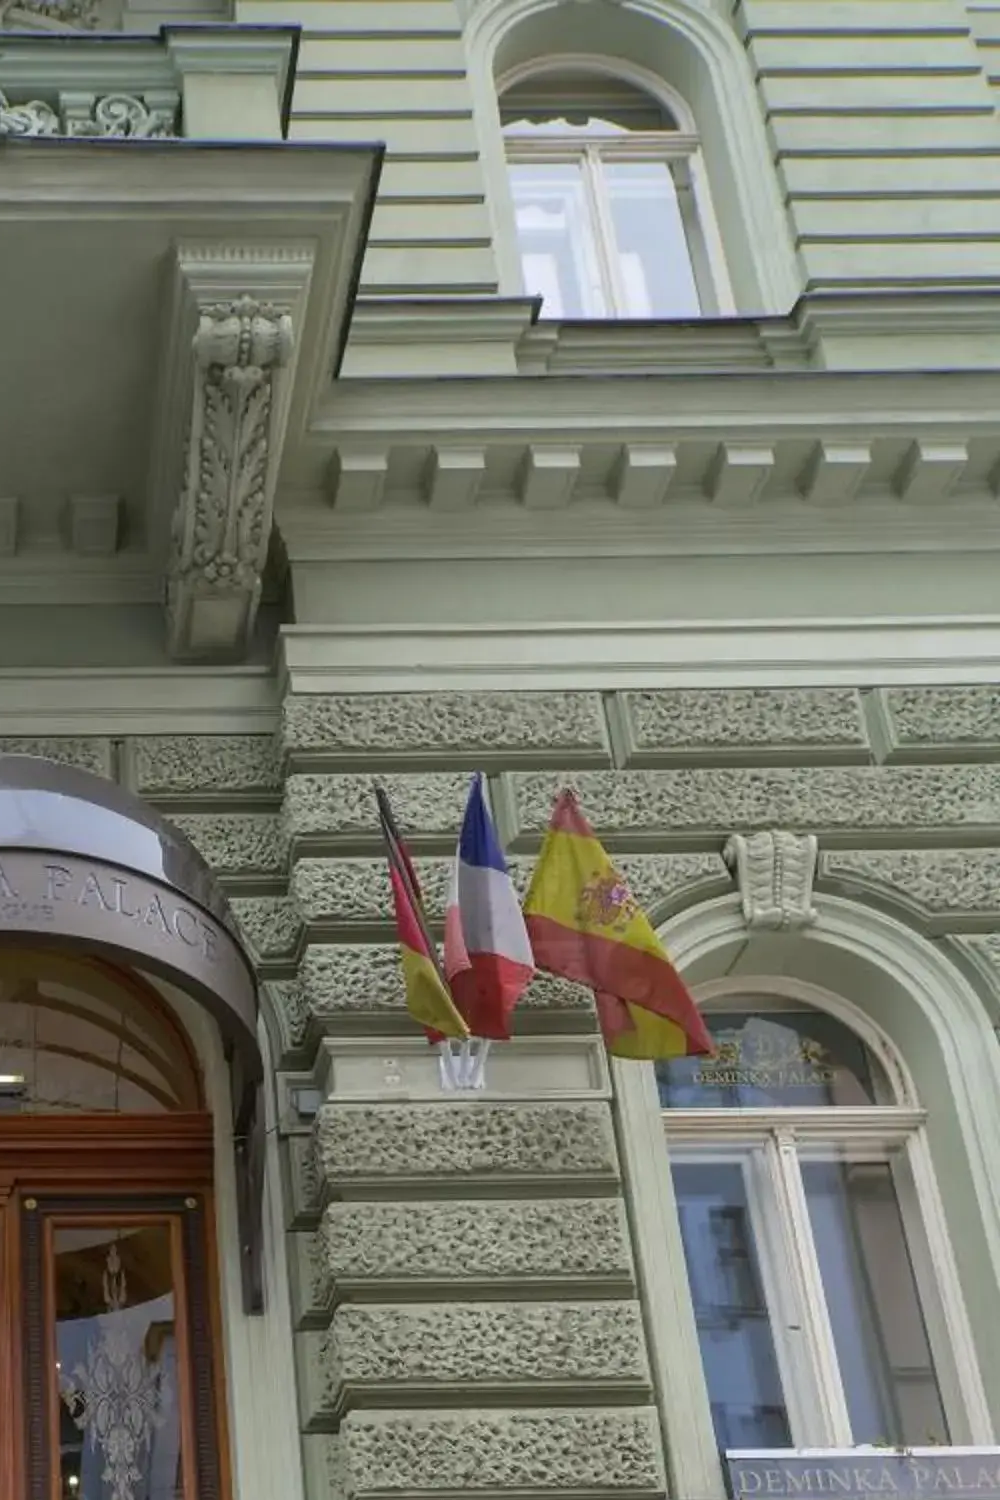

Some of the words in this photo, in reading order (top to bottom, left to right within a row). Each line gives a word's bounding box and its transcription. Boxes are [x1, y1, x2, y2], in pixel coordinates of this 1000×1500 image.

[43, 863, 221, 961] PALACE
[691, 1071, 772, 1084] DEMINKA
[739, 1468, 898, 1494] DEMINKA
[911, 1466, 1000, 1490] PALA
